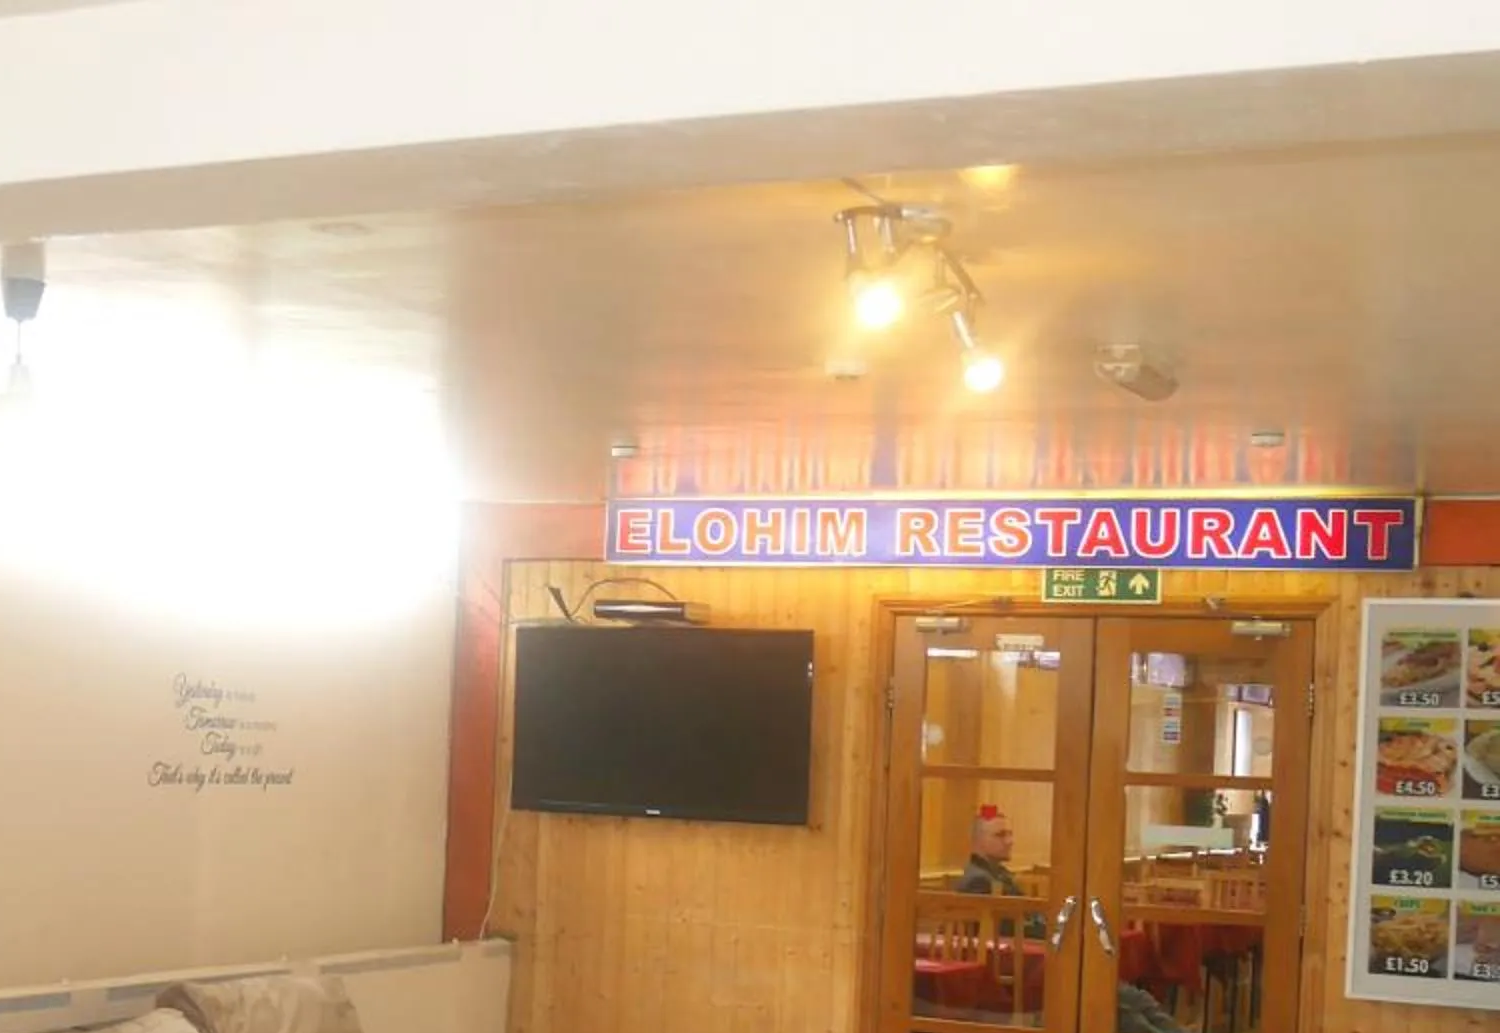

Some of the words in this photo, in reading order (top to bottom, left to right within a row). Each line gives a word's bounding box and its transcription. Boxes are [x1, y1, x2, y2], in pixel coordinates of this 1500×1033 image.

[616, 508, 868, 556] ELOHIM
[894, 508, 1405, 561] RESTAURANT
[1053, 570, 1085, 581] FIRE
[1053, 585, 1085, 597] EXIT
[1389, 869, 1433, 886] £3.20
[1386, 957, 1429, 974] £1.50
